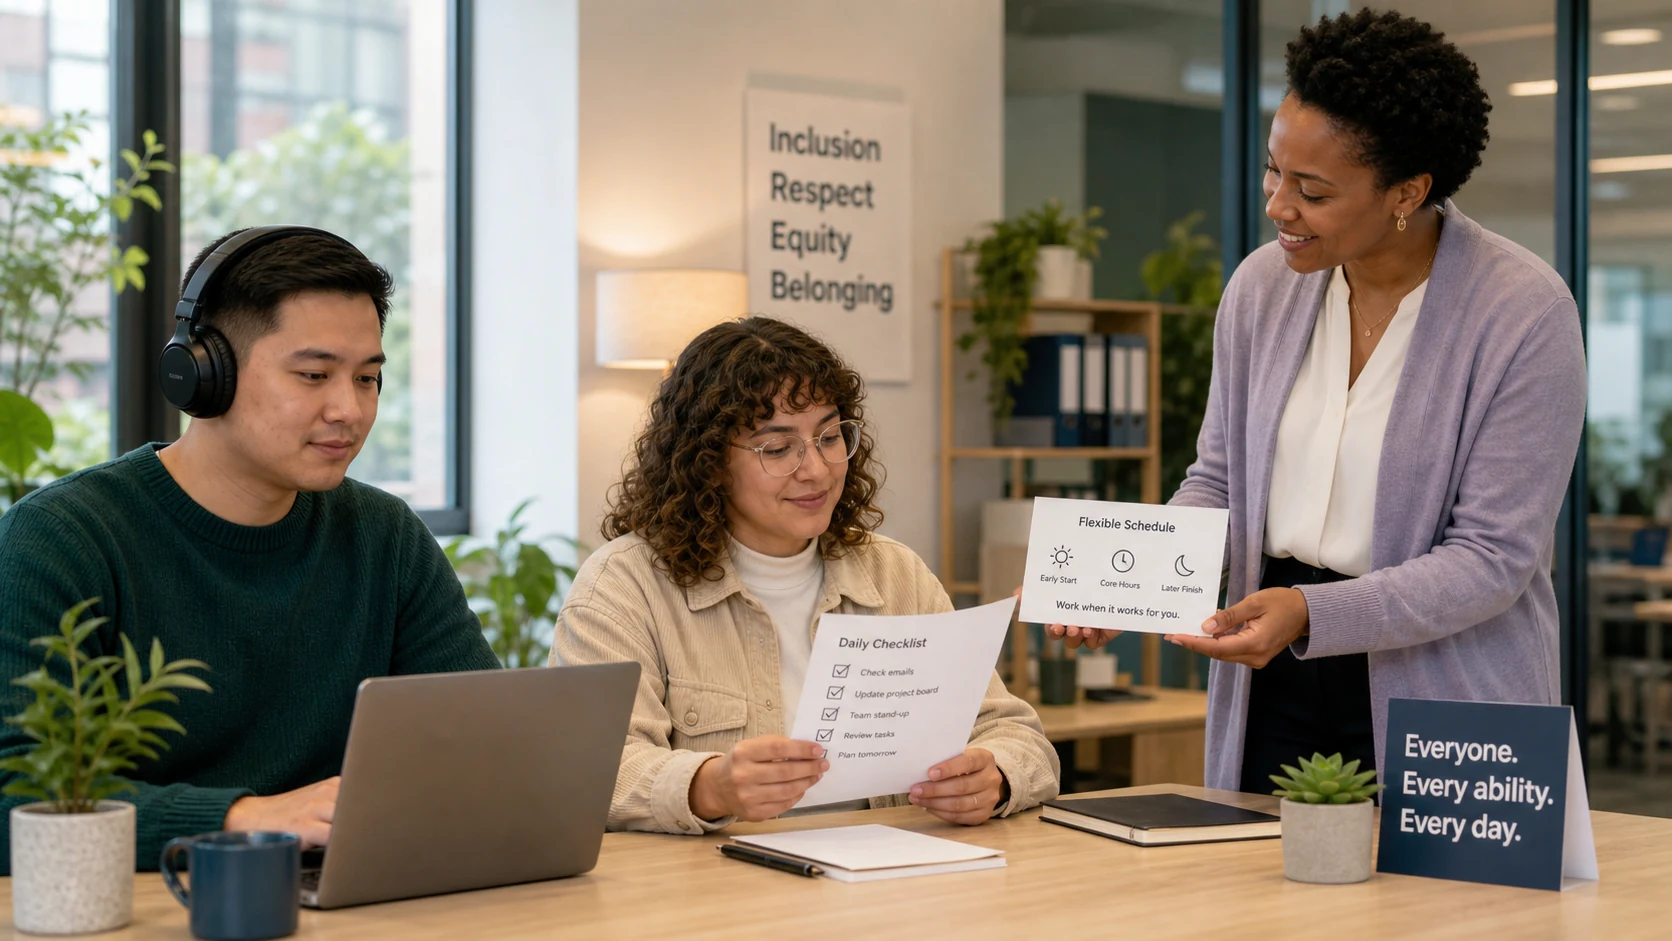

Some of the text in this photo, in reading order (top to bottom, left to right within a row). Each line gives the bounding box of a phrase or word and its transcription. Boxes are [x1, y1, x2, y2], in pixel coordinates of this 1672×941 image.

[769, 122, 881, 162] Inclusion
[770, 171, 875, 212] Respect
[770, 221, 851, 262] Equity
[770, 270, 894, 314] Belonging
[1078, 516, 1176, 533] Flexible Schedule
[1040, 574, 1077, 585] Early Start
[1100, 579, 1140, 590] Core Hours
[1161, 584, 1203, 594] Later Finish
[1056, 600, 1180, 620] Work when it works for you.
[839, 637, 927, 651] Daily Checklist
[860, 667, 914, 677] Check emails
[855, 686, 939, 699] Update project board
[850, 710, 910, 719] Team stand-up
[844, 730, 895, 739] Review tasks
[837, 750, 897, 759] Plan tomorrow
[1405, 733, 1518, 766] Everyone.
[1403, 770, 1554, 811] Every ability.
[1400, 808, 1522, 846] Every day.
